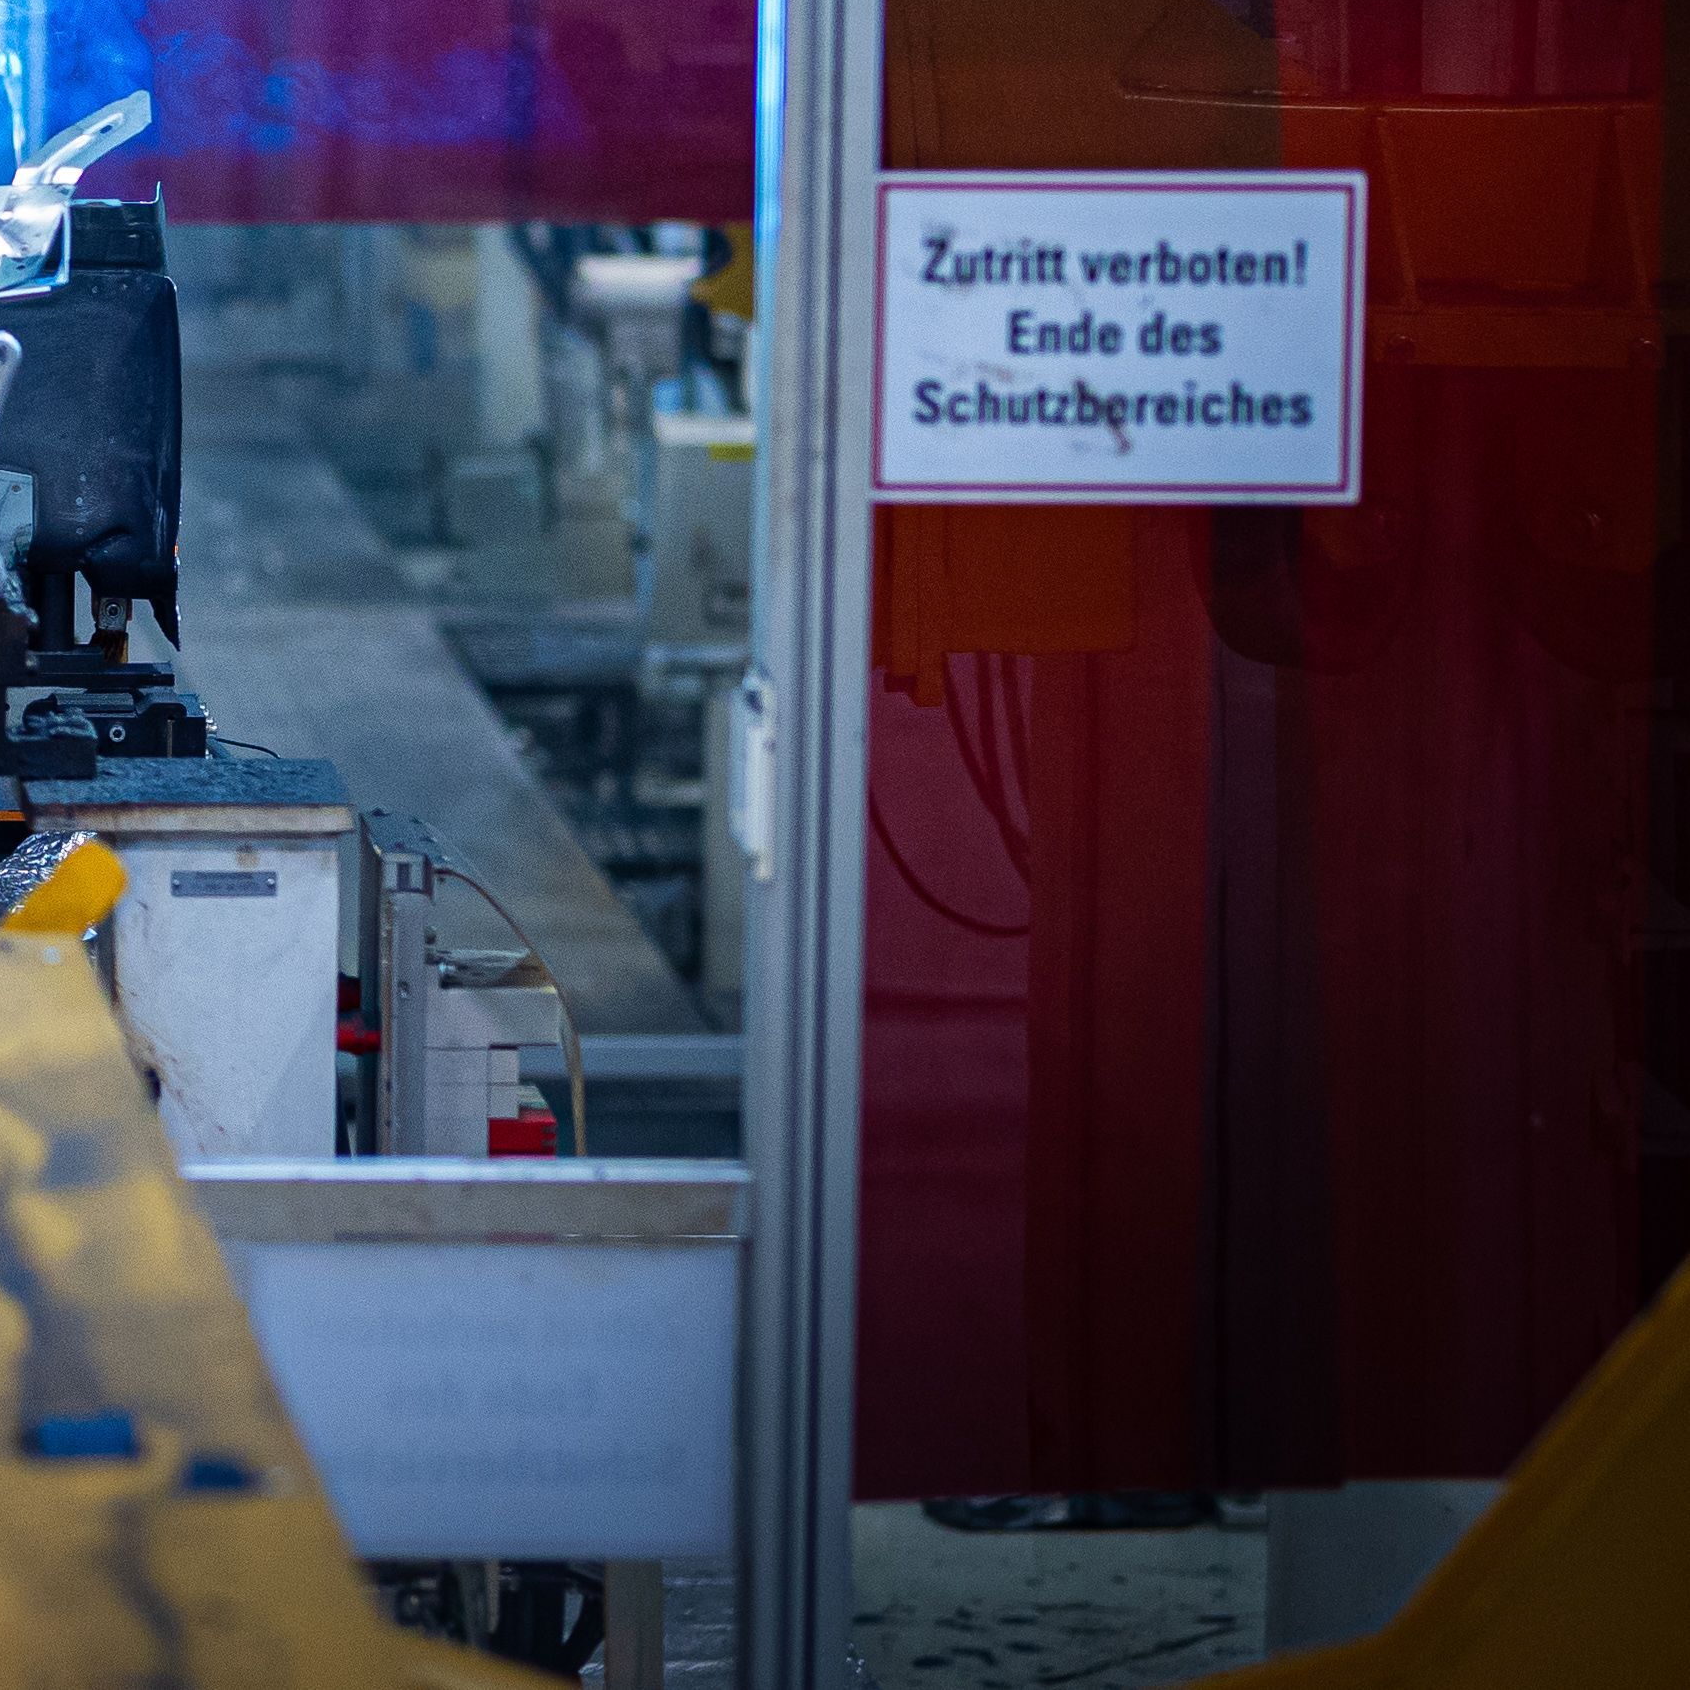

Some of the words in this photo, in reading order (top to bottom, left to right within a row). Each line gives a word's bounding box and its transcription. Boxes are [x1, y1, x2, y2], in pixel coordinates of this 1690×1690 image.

[922, 237, 1068, 286] Zutritt
[1080, 239, 1310, 287] verboten!
[1006, 309, 1124, 356] Ende
[1136, 311, 1224, 357] des
[912, 378, 1314, 428] Schutzbereiches
